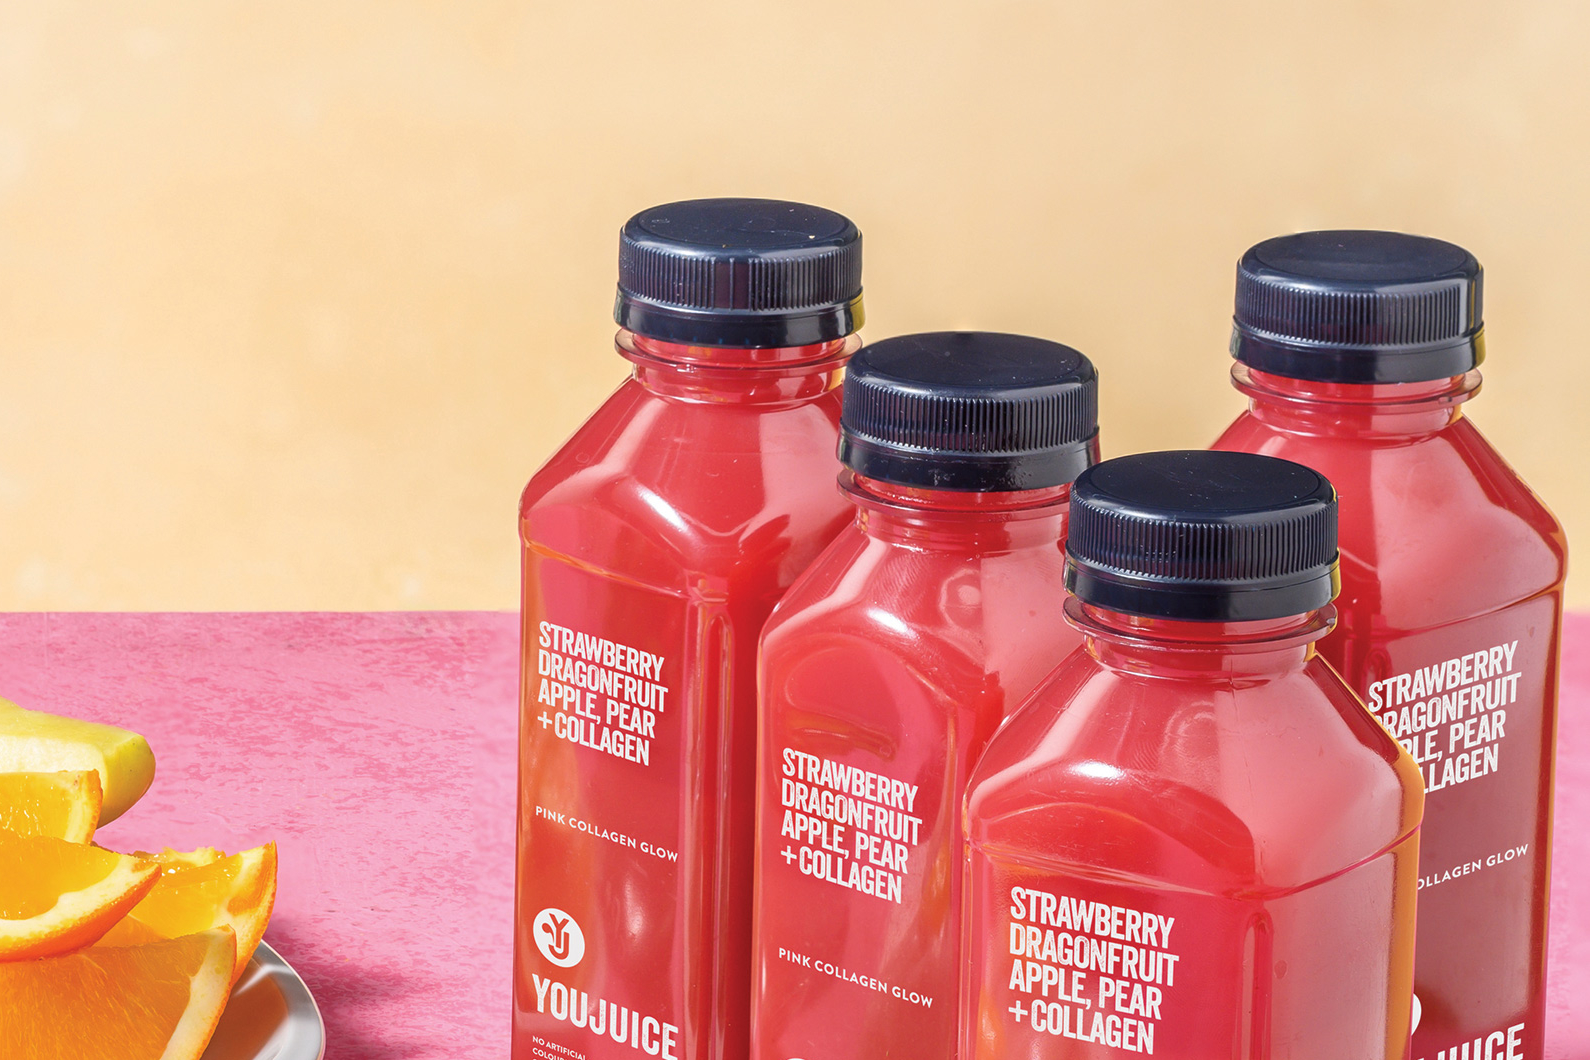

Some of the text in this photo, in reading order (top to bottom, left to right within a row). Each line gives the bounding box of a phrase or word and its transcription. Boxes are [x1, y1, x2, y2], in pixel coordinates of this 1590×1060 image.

[538, 649, 668, 712] DRAGONFRUIT
[539, 621, 664, 681] STRAWBERRY
[1368, 640, 1518, 712] STRAWBERRY
[538, 679, 655, 738] APPLE, PEAR
[1398, 710, 1506, 764] PLE, PEAR
[782, 748, 918, 812] STRAWBERRY
[536, 806, 678, 862] PINK COLLAGEN GLOW
[781, 810, 908, 874] APPLE, PEAR
[782, 778, 922, 846] DRAGONFRUIT
[1418, 844, 1529, 890] OLLAGEN GLOW
[1011, 887, 1175, 949] STRAWBERRY
[779, 948, 932, 1008] PINK COLLAGEN GLOW
[1010, 922, 1179, 986] DRAGONFRUIT
[1009, 959, 1162, 1020] APPLE, PEAR
[533, 1036, 544, 1045] NO
